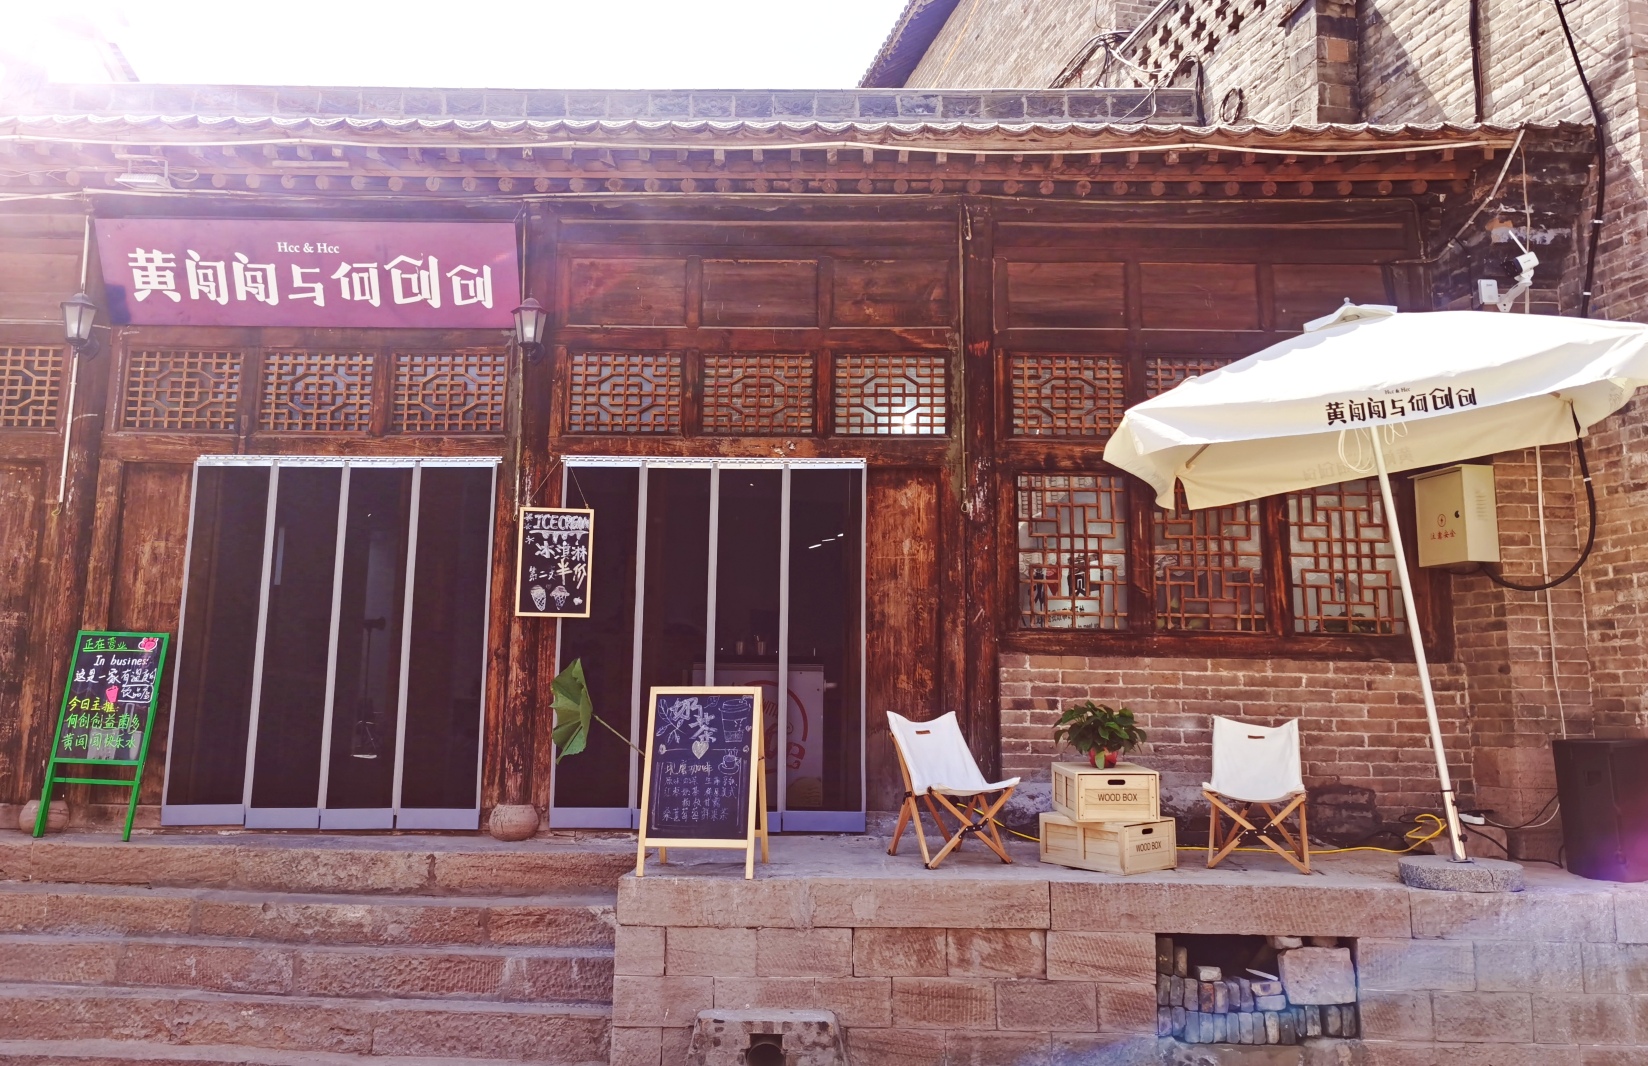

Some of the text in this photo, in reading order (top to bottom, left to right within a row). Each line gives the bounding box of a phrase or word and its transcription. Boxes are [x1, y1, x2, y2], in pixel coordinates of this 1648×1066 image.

[277, 241, 340, 254] Hcc & Hcc
[127, 247, 493, 309] 黄闯闯与何创创
[1325, 386, 1477, 426] 黄闯闯与何创创
[534, 540, 587, 562] 冰淇淋
[84, 637, 127, 650] 正在营业
[93, 655, 105, 666] In
[121, 687, 151, 699] 饮品店
[669, 697, 718, 743] 奶茶
[665, 760, 713, 776] 现磨咖啡
[1098, 793, 1138, 802] WOOD BOX
[1135, 840, 1162, 853] WOOD BOX
